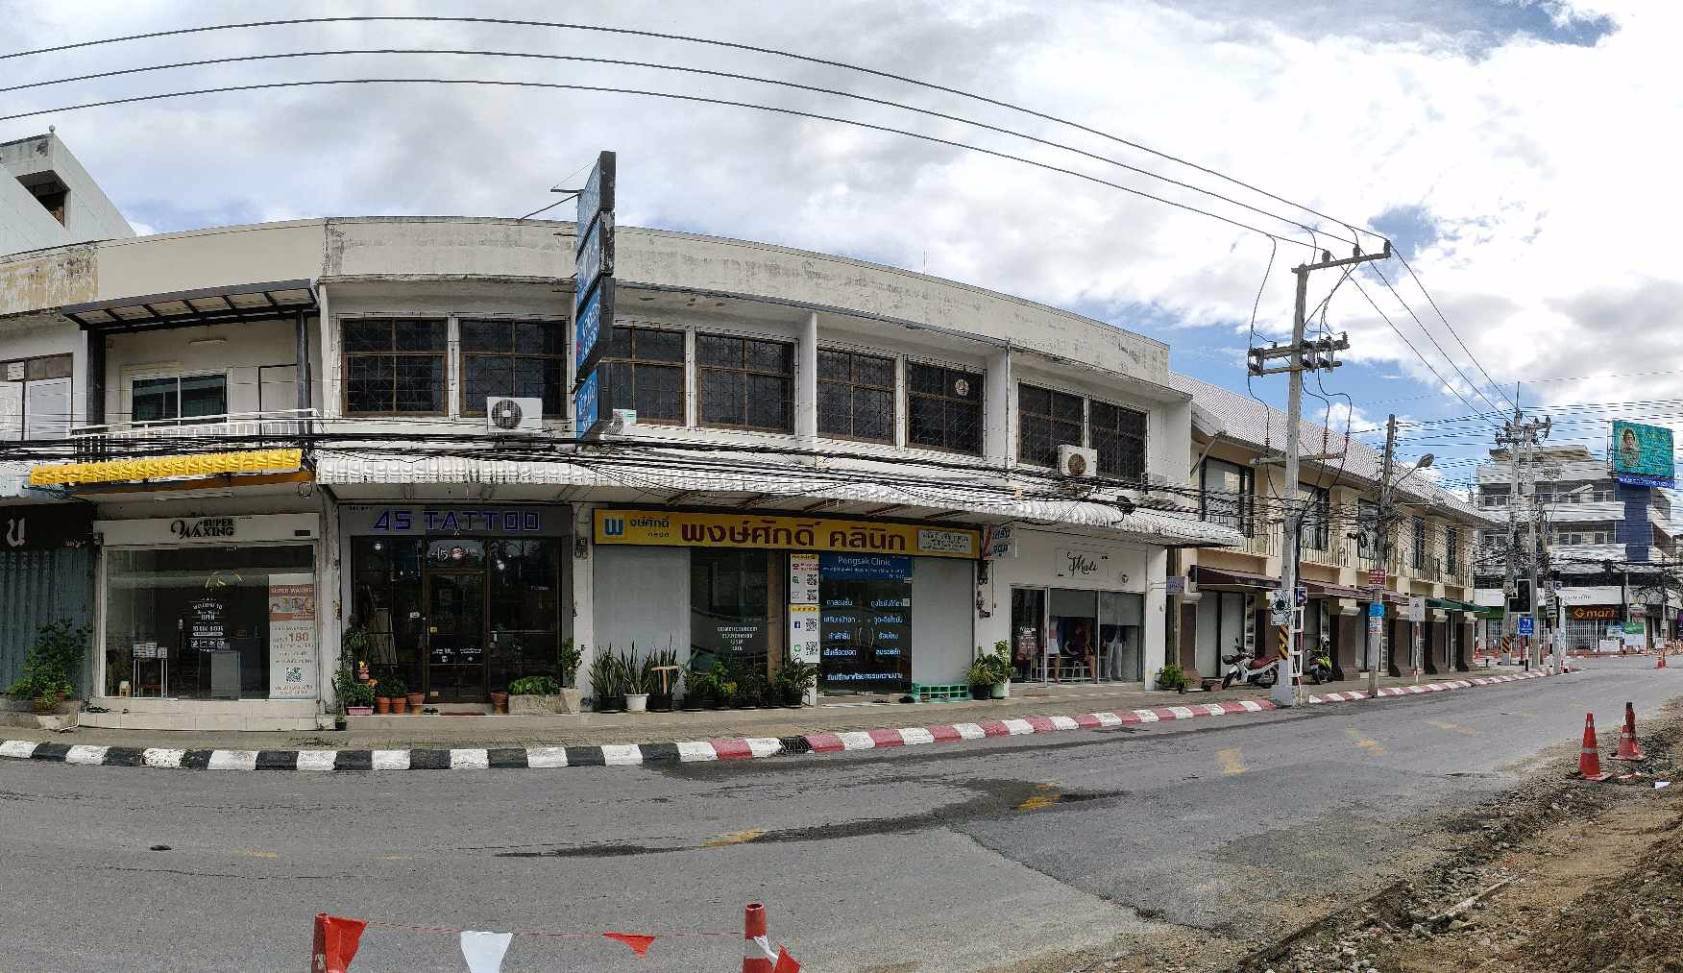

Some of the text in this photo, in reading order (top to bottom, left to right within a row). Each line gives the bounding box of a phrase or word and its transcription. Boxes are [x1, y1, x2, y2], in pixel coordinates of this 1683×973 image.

[423, 511, 541, 531] TATTOO
[679, 517, 823, 546] พงษ์ศักดิ์
[829, 525, 905, 551] คลินิก
[870, 556, 891, 567] Clinic
